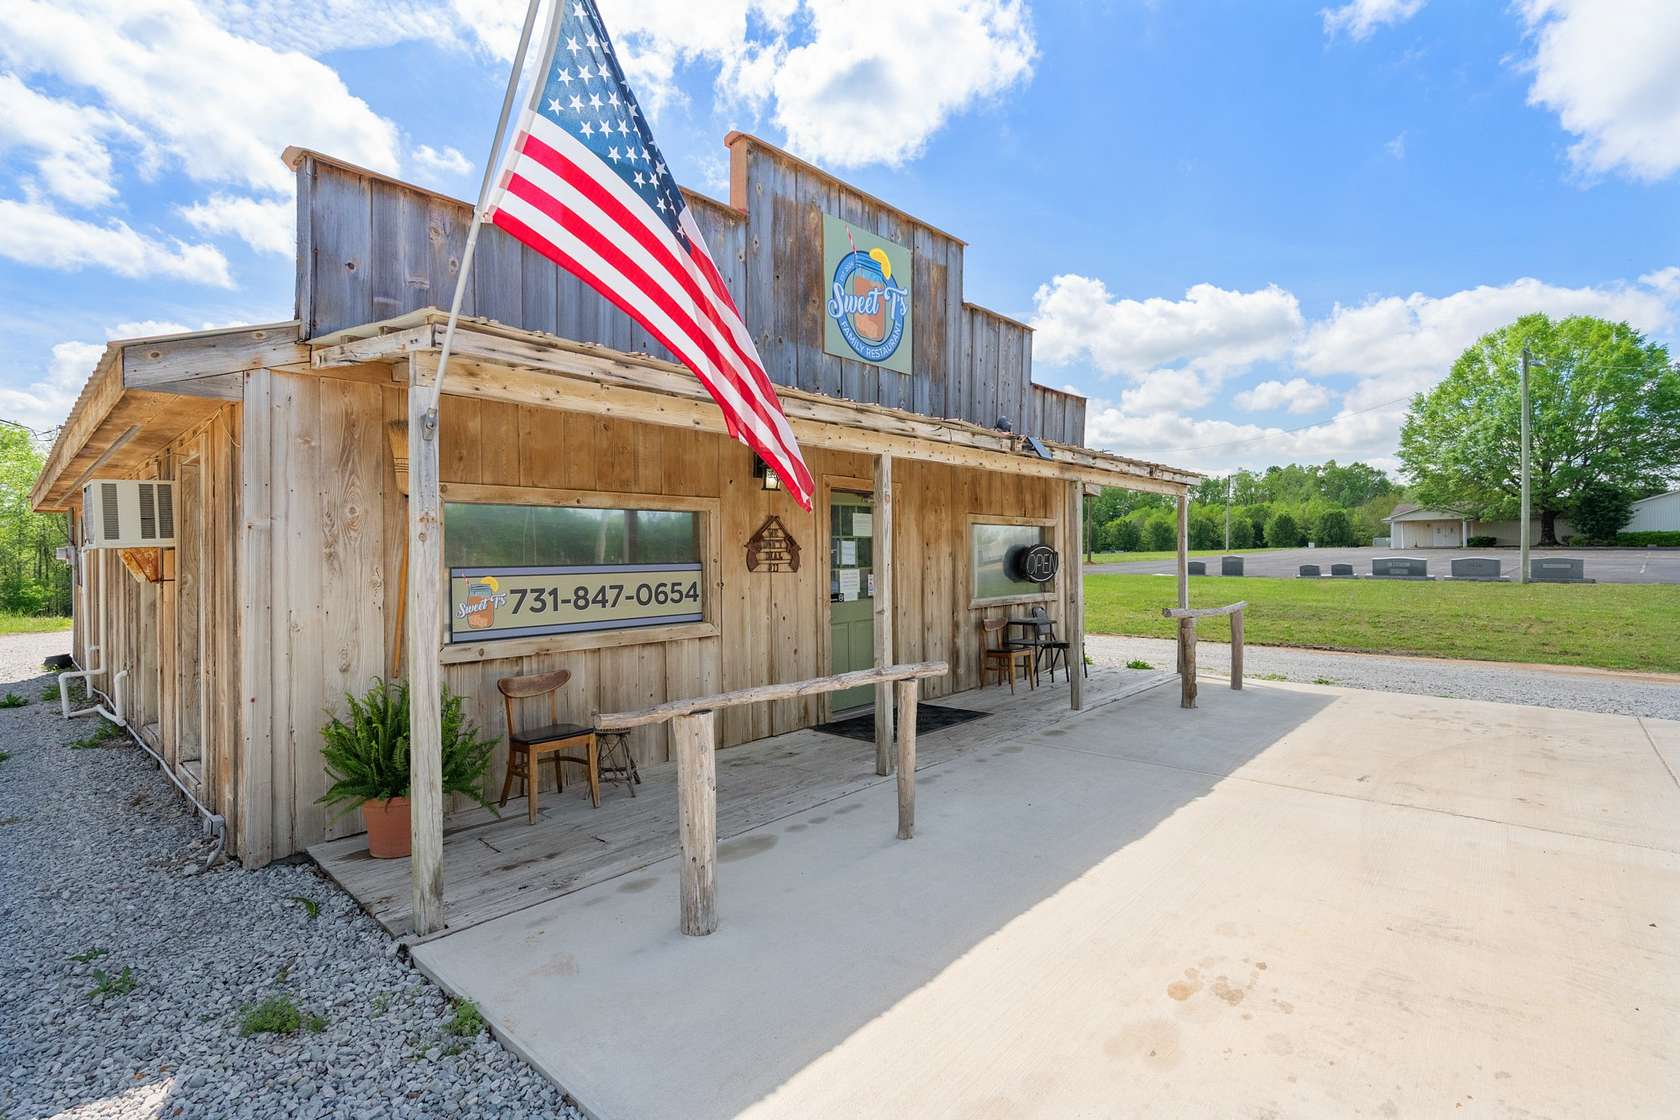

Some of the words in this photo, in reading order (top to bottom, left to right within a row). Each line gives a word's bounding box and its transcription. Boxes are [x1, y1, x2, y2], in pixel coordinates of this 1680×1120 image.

[827, 282, 883, 319] Sweet
[841, 321, 865, 353] FAMILY
[866, 323, 902, 358] RESTAURANT
[1026, 553, 1058, 575] OPEN
[456, 600, 490, 618] Sweet
[510, 581, 700, 615] 731-847-0654
